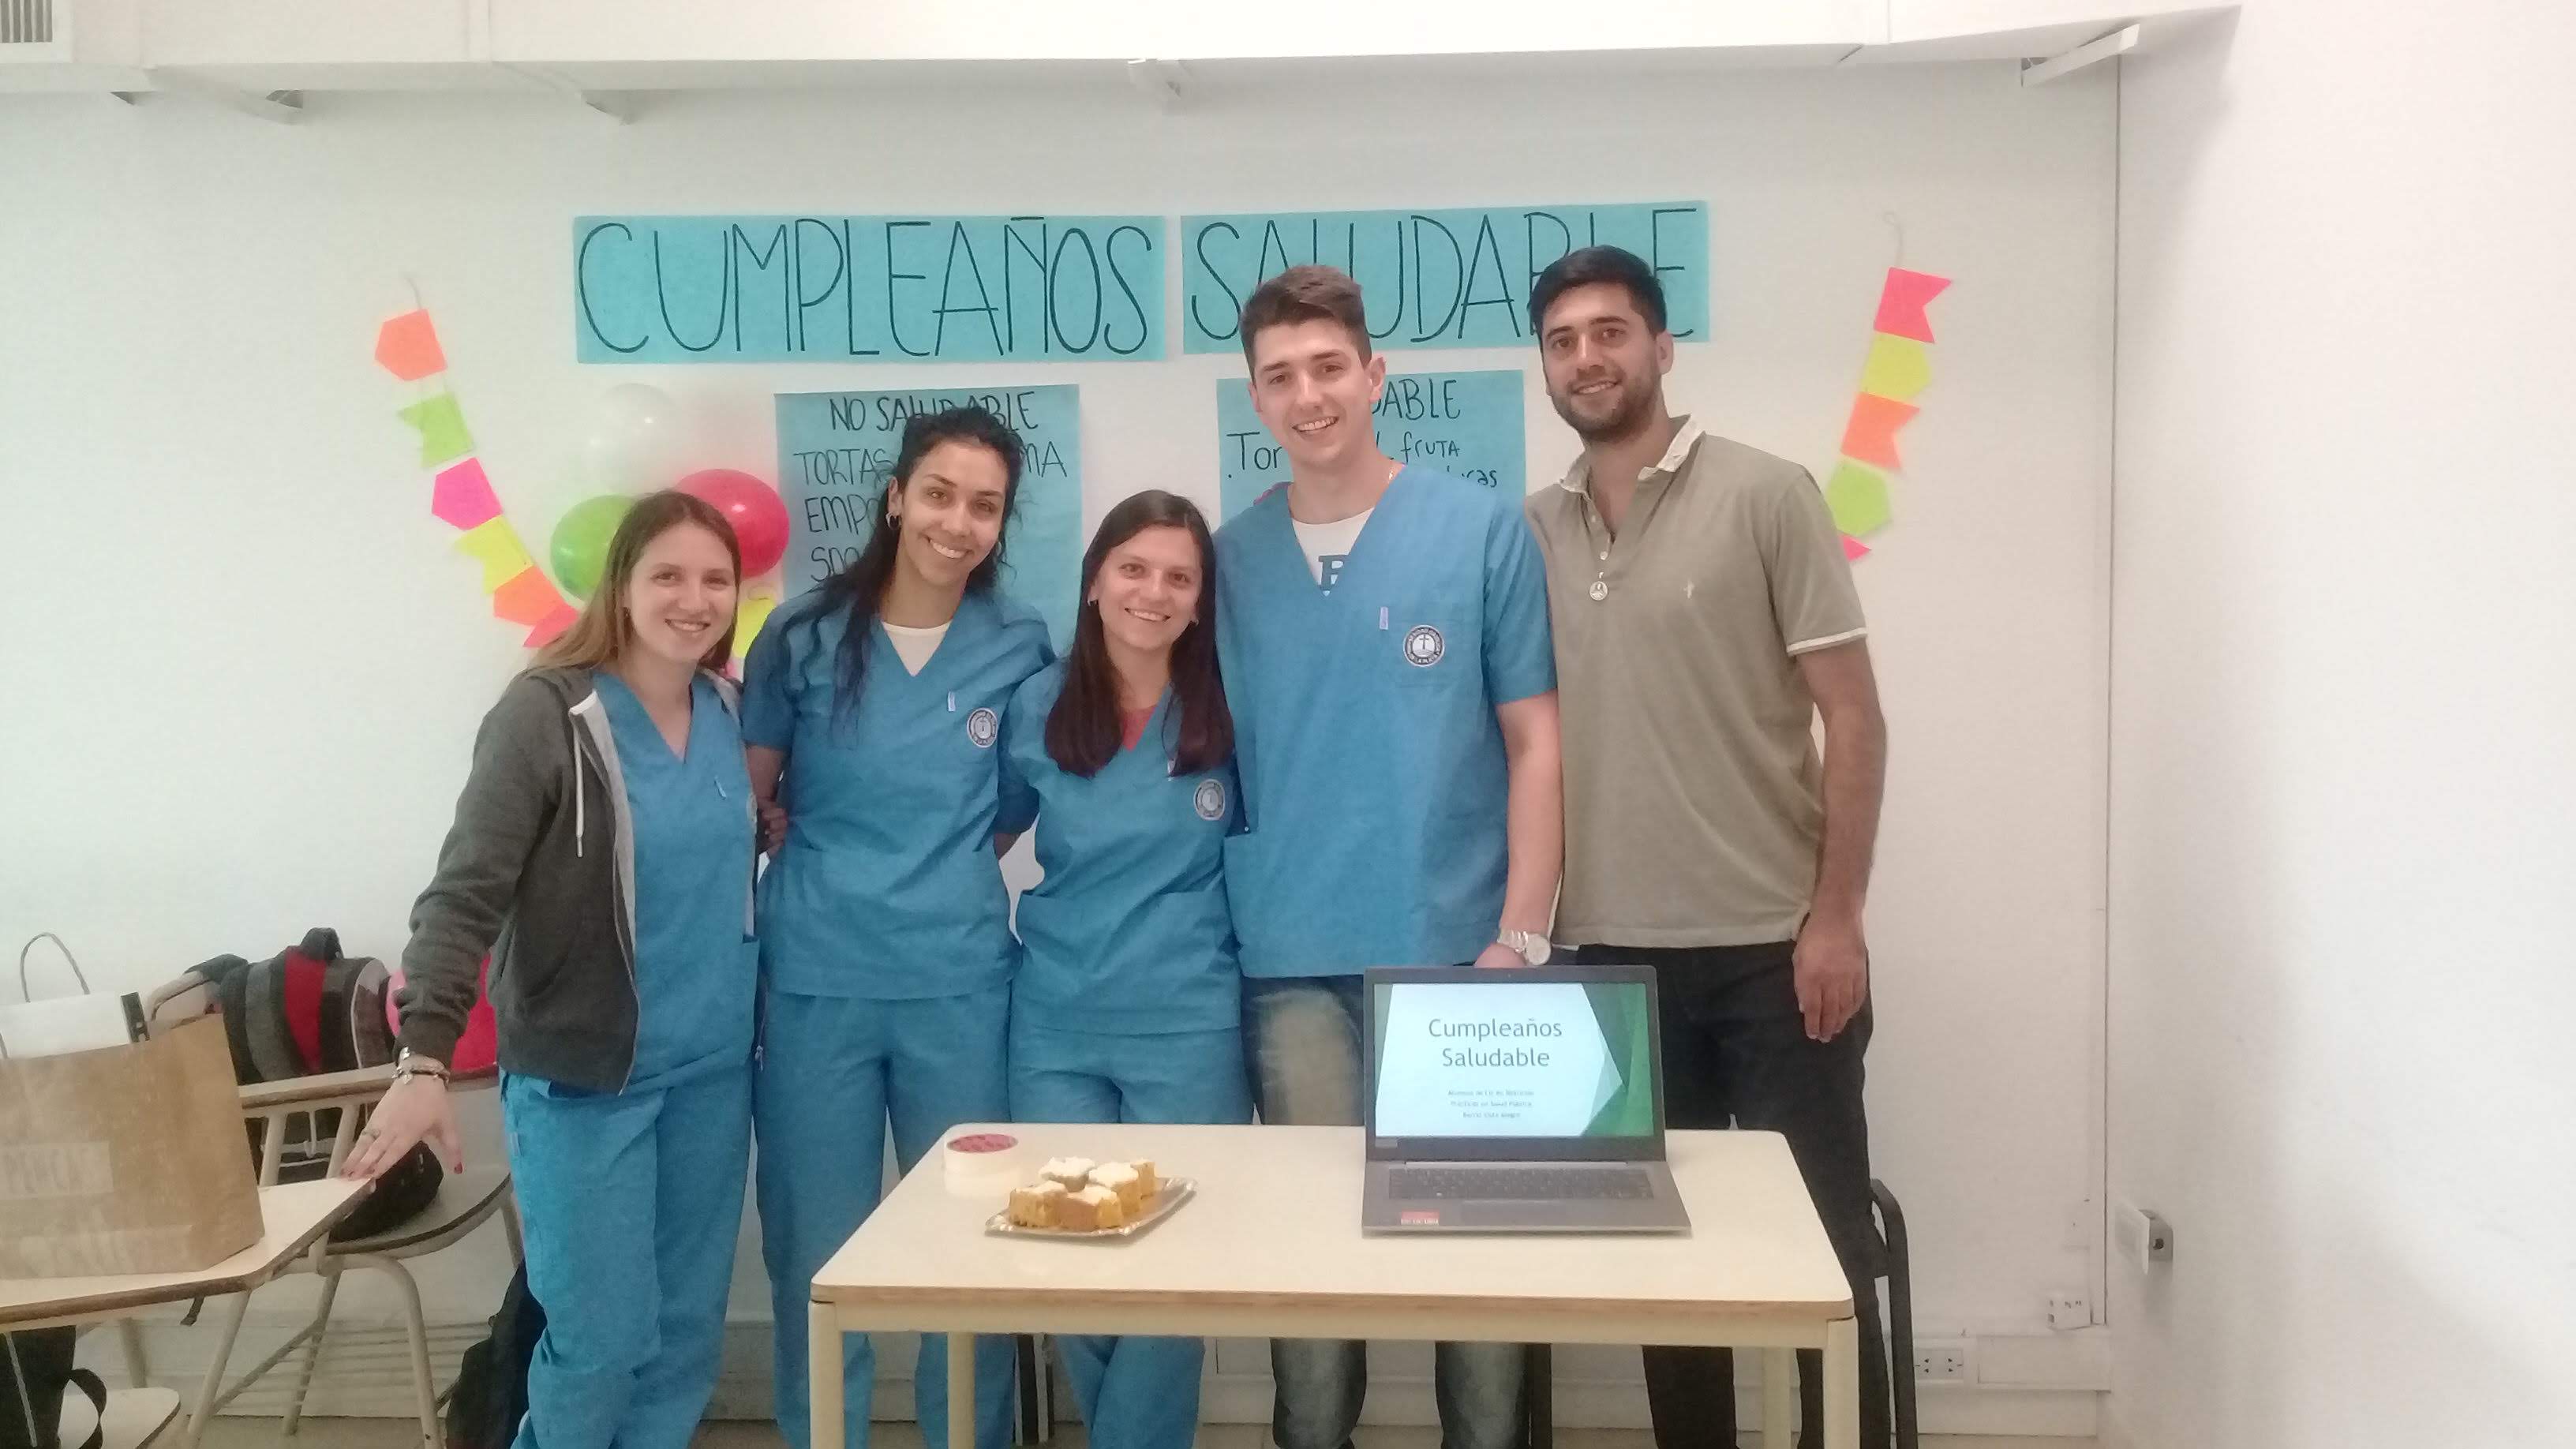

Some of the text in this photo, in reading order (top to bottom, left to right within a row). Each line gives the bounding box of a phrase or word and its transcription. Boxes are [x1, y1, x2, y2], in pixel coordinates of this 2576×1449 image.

[578, 217, 1151, 356] CUMPLEAÑOS
[829, 397, 866, 431] NO
[793, 448, 895, 485] TORTAS
[1428, 1017, 1563, 1043] Cumpleaños
[1442, 1047, 1550, 1067] Saludable
